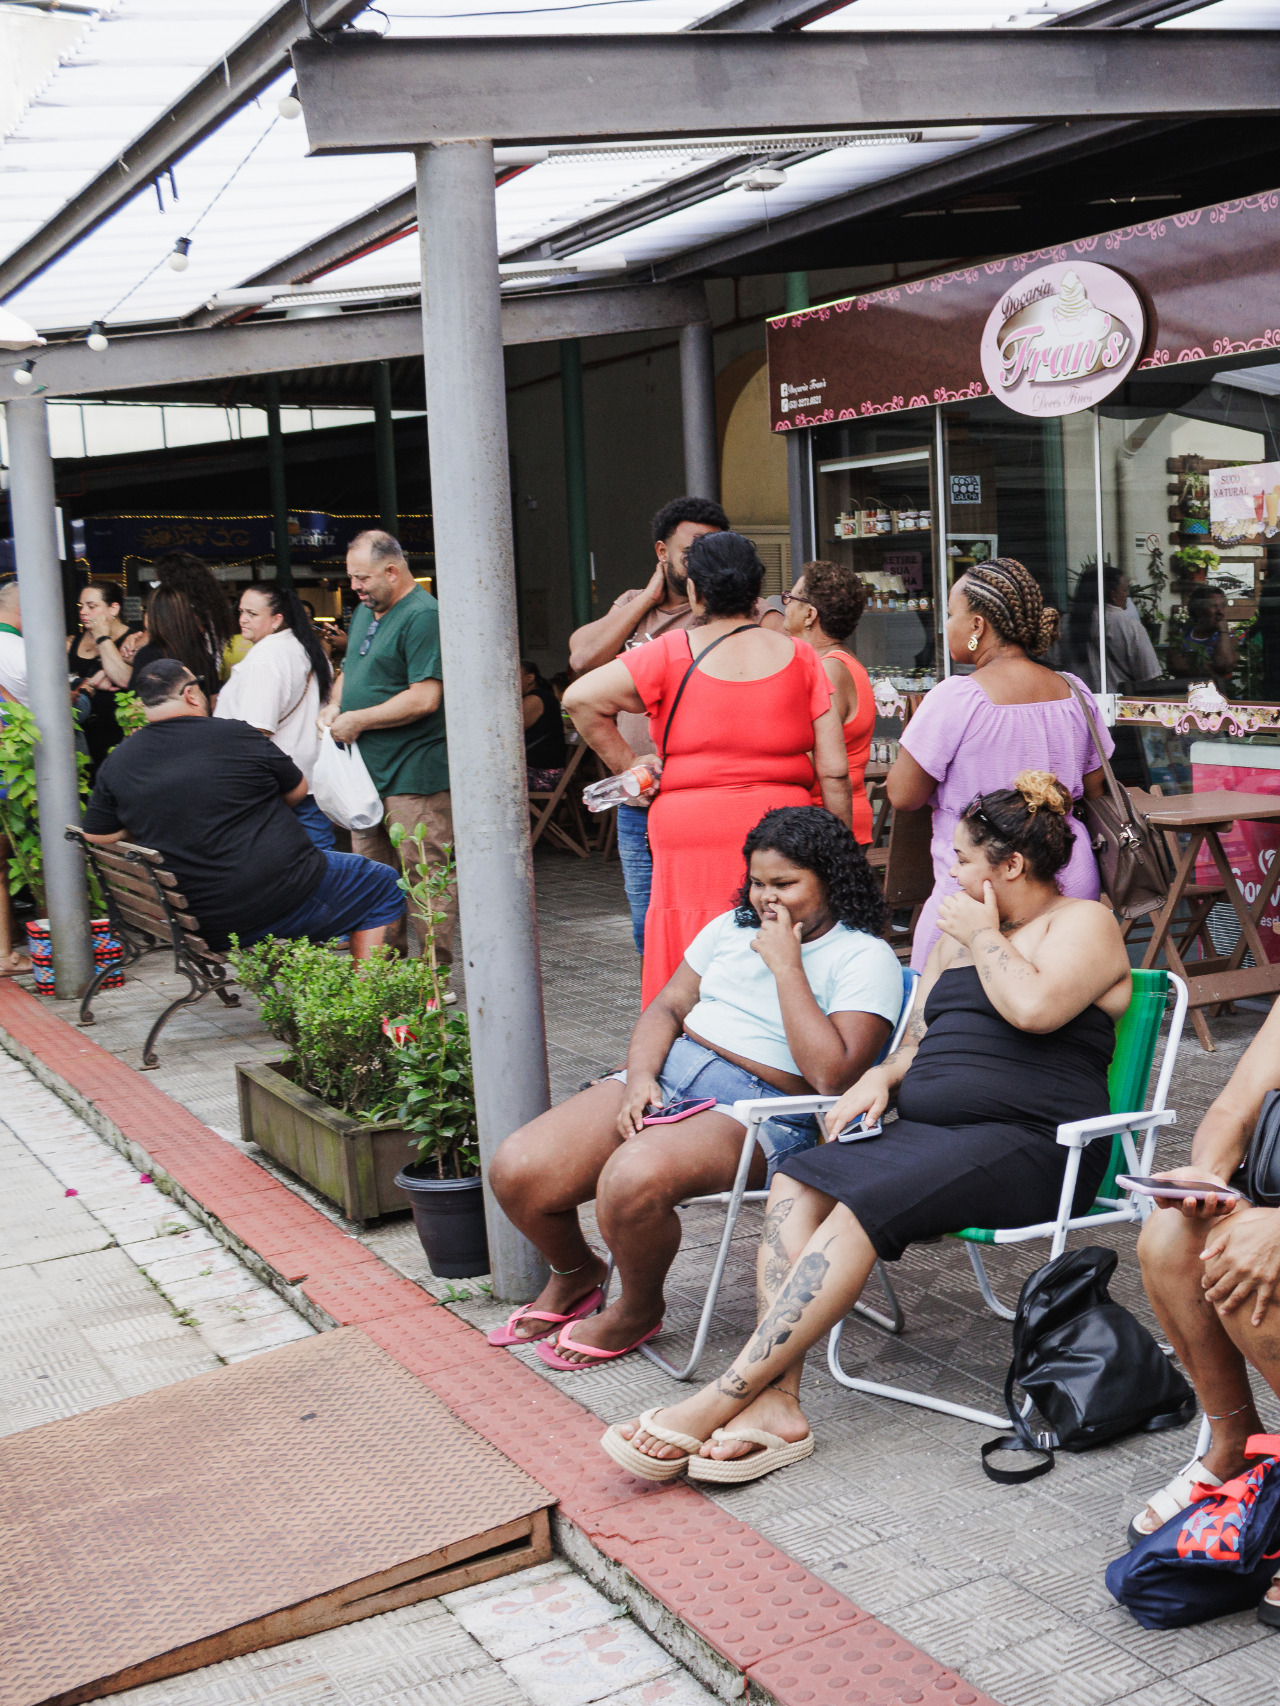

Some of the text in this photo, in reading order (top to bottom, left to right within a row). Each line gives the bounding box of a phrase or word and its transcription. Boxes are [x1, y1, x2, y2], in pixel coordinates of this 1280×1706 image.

[1002, 279, 1052, 321] Doçaria
[1000, 314, 1130, 388] Fran's
[952, 475, 979, 485] COSTA
[1221, 475, 1240, 484] SUCO
[952, 484, 979, 494] DOCE
[1213, 487, 1249, 498] NATURAL
[890, 566, 910, 575] SUA
